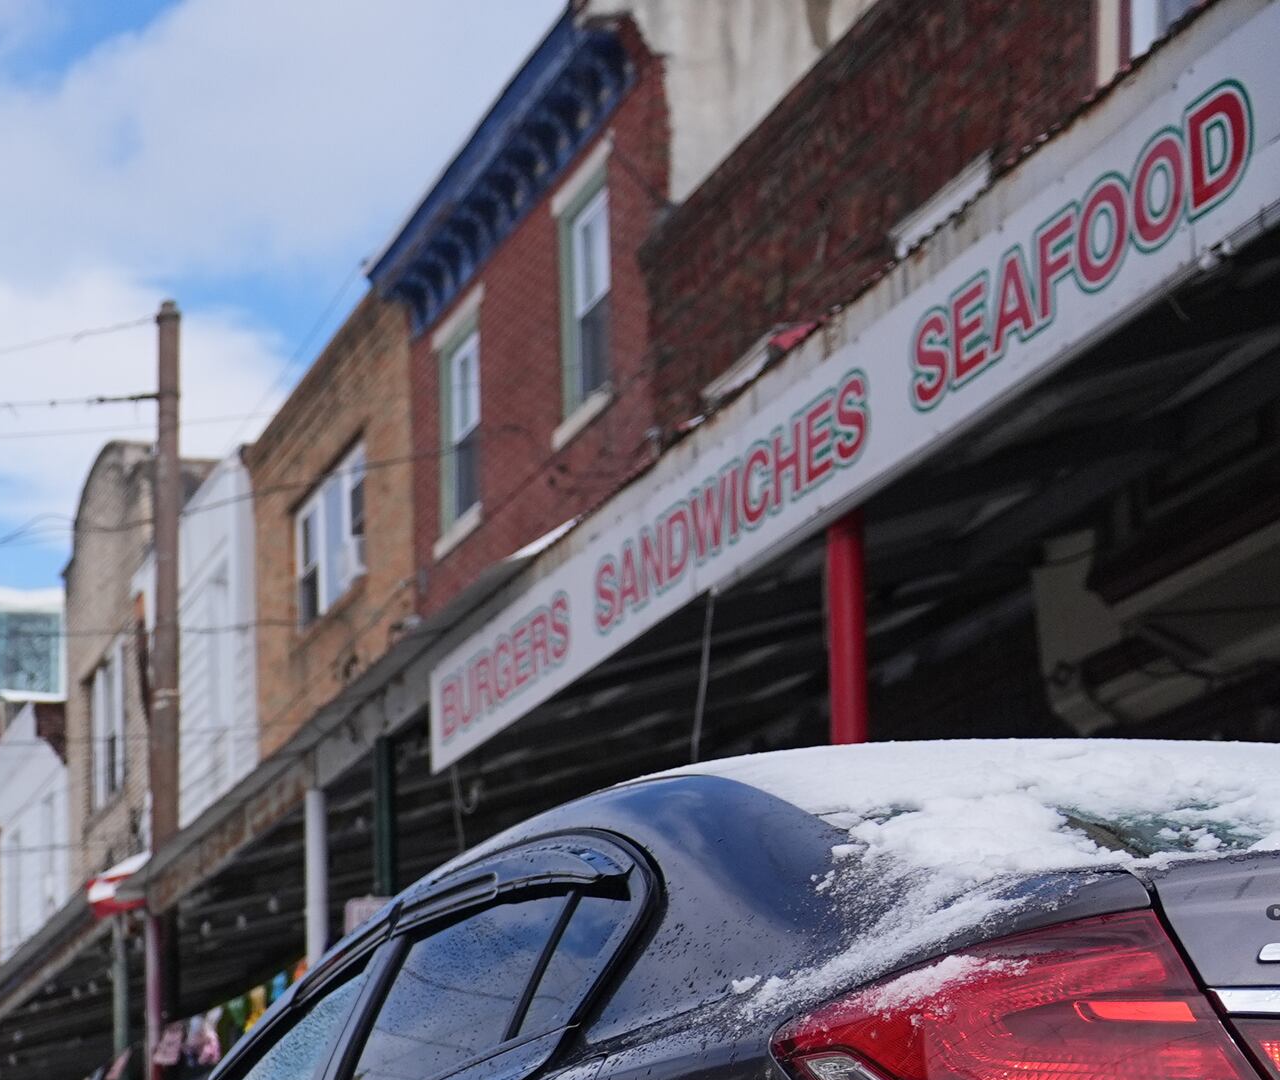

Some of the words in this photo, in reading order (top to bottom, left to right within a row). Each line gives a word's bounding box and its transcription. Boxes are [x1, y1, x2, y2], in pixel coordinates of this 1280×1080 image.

[439, 590, 571, 746] BURGERS
[593, 368, 870, 637] SANDWICHES
[911, 78, 1253, 413] SEAFOOD
